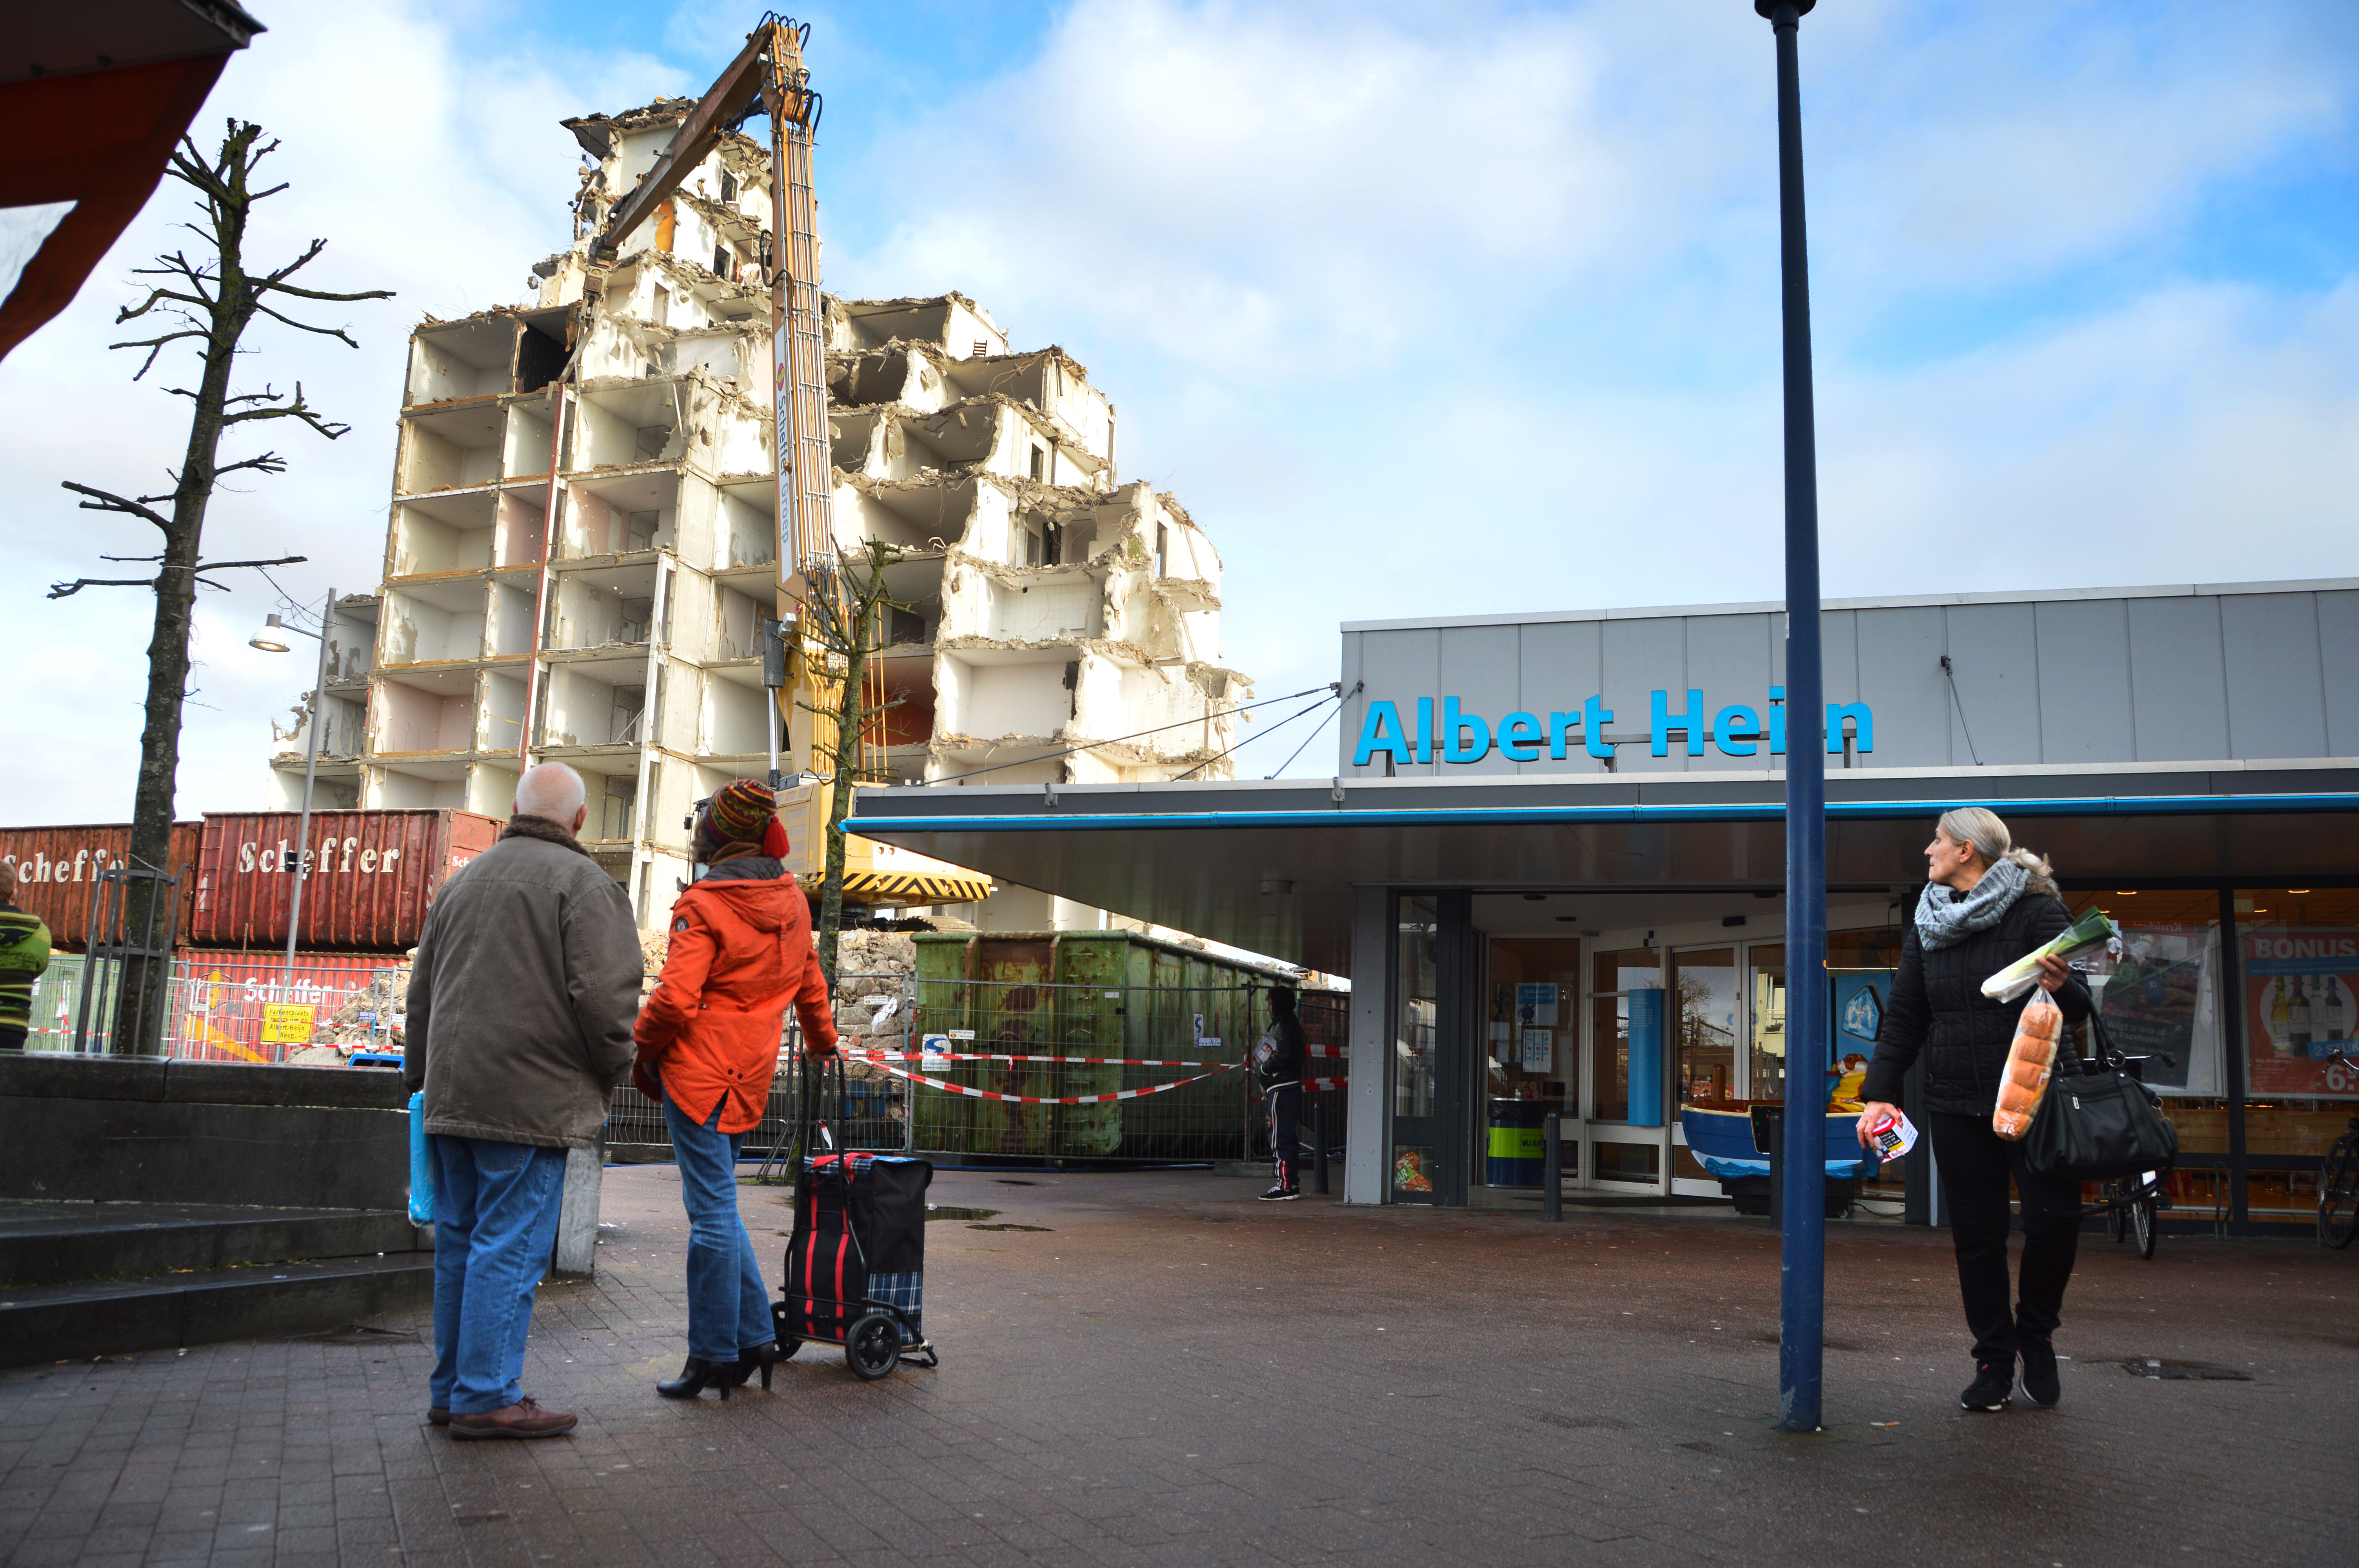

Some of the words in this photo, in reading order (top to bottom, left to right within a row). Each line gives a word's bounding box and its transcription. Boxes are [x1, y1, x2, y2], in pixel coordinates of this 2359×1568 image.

[778, 395, 788, 476] Scheffer
[781, 482, 789, 543] Groep
[1353, 693, 1614, 766] Albert
[1650, 686, 1874, 758] Hein
[2255, 938, 2357, 959] BONUS
[244, 977, 333, 1004] Schffer
[2106, 1021, 2128, 1031] Volgt
[2119, 1031, 2165, 1044] Facebook?
[2315, 1045, 2323, 1056] 2
